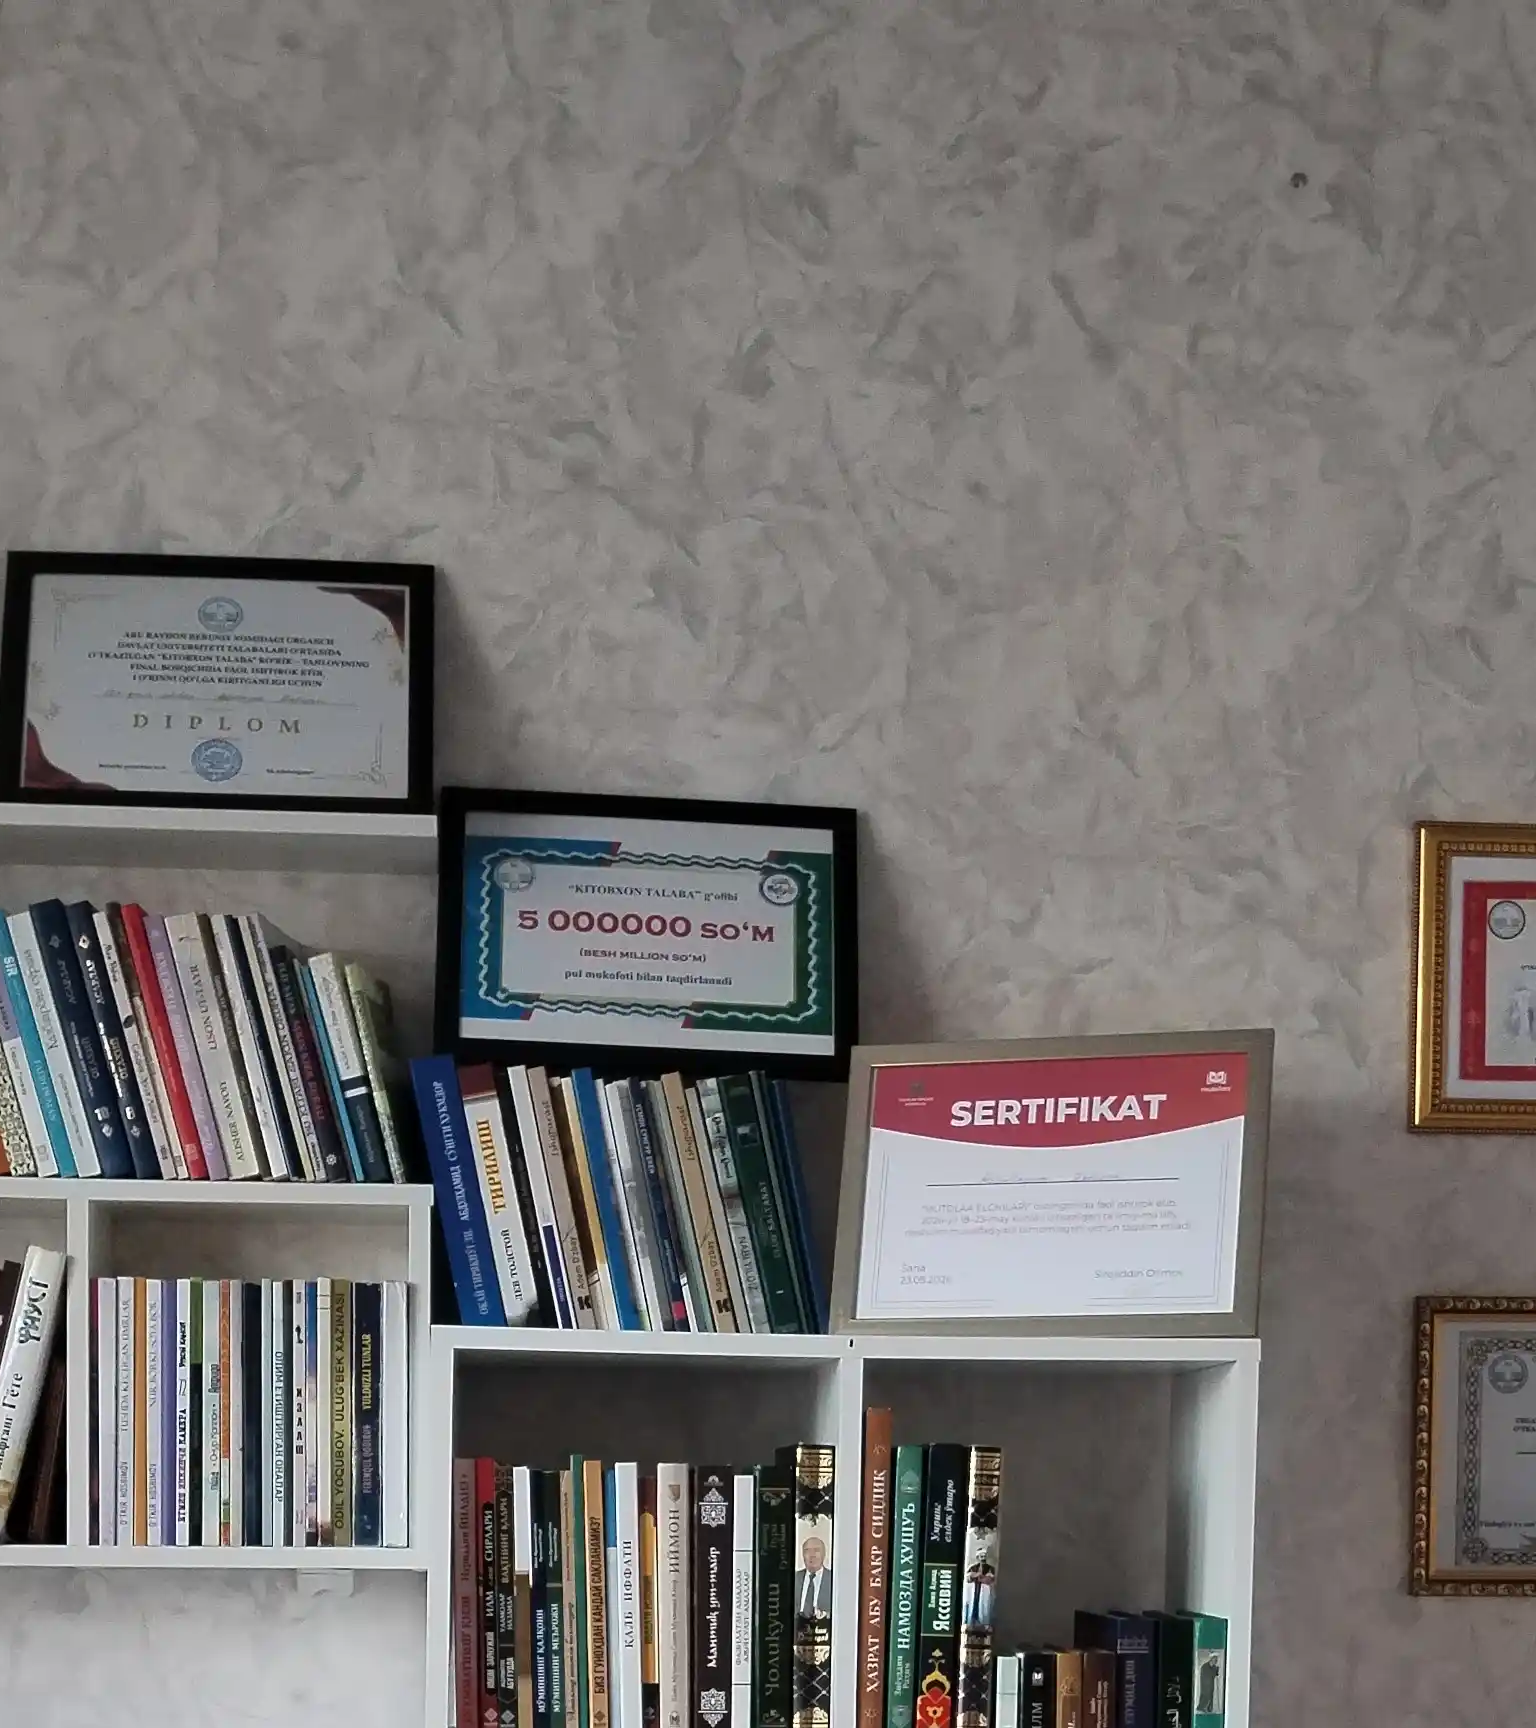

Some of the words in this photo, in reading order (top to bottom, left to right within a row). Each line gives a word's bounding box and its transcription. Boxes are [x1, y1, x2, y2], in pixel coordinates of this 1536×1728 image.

[132, 713, 302, 735] DIPLOM
[516, 909, 540, 930] 5
[547, 909, 692, 939] 000000
[579, 947, 617, 961] (BESH
[619, 950, 670, 963] MILLION
[564, 969, 583, 983] pul
[635, 970, 663, 984] bilan
[665, 972, 733, 987] taqdirlanadi
[949, 1093, 1168, 1129] SERTIFIKAT
[476, 1118, 507, 1216] ТИРИЛИШ
[500, 1227, 521, 1279] ТОЛСТОЙ
[16, 1276, 49, 1344] ФАУСТ
[509, 1279, 524, 1302] ЛЕВ
[333, 1292, 346, 1353] XAZINASI
[273, 1350, 285, 1383] ОЛИМ
[360, 1333, 373, 1368] TUNLAR
[0, 1372, 25, 1410] Гёте
[333, 1356, 345, 1422] ULUG'BEK
[360, 1368, 373, 1411] YULDUZLI
[333, 1428, 346, 1496] YOQUBOV.
[333, 1498, 345, 1530] ODIL
[869, 1471, 887, 1541] СИДДИҚ
[483, 1510, 494, 1563] СИРЛАРИ
[666, 1509, 682, 1575] ИЙМОН
[898, 1503, 917, 1566] ХУШУЪ
[622, 1540, 634, 1602] ИФФАТИ
[868, 1546, 884, 1590] БАКР
[483, 1590, 495, 1618] ИЛМ
[590, 1586, 604, 1625] КАНДАЙ
[867, 1596, 883, 1631] АБУ
[895, 1568, 915, 1652] НАМОЗДА
[933, 1569, 954, 1634] Яссавий
[623, 1611, 636, 1650] ҚАЛБ
[535, 1656, 546, 1714] МЎМИННИНГ
[550, 1655, 560, 1714] МЎМИННИНГ
[592, 1675, 605, 1695] БИЗ
[865, 1635, 882, 1695] ҲАЗРАТ
